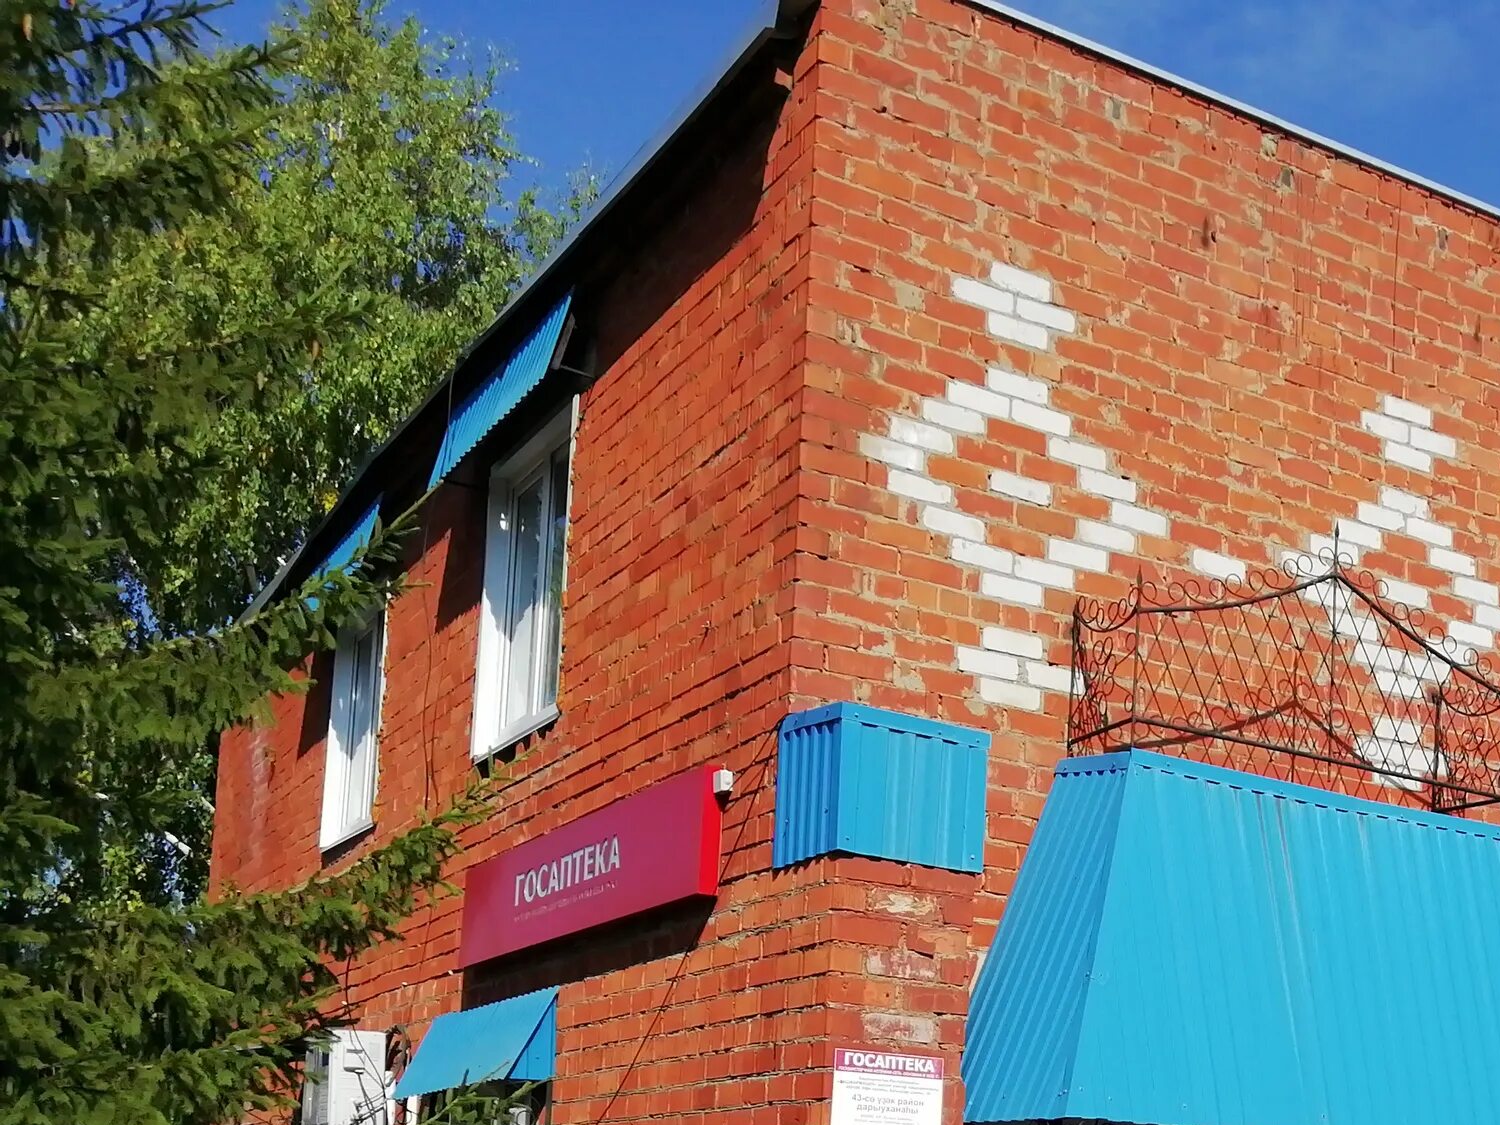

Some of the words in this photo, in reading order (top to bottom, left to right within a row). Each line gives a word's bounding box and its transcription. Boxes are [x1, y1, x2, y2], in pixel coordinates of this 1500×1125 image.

[514, 836, 621, 907] ГОСАПТЕКА
[844, 1052, 935, 1072] ГОСАПТЕКА
[897, 1097, 924, 1107] район
